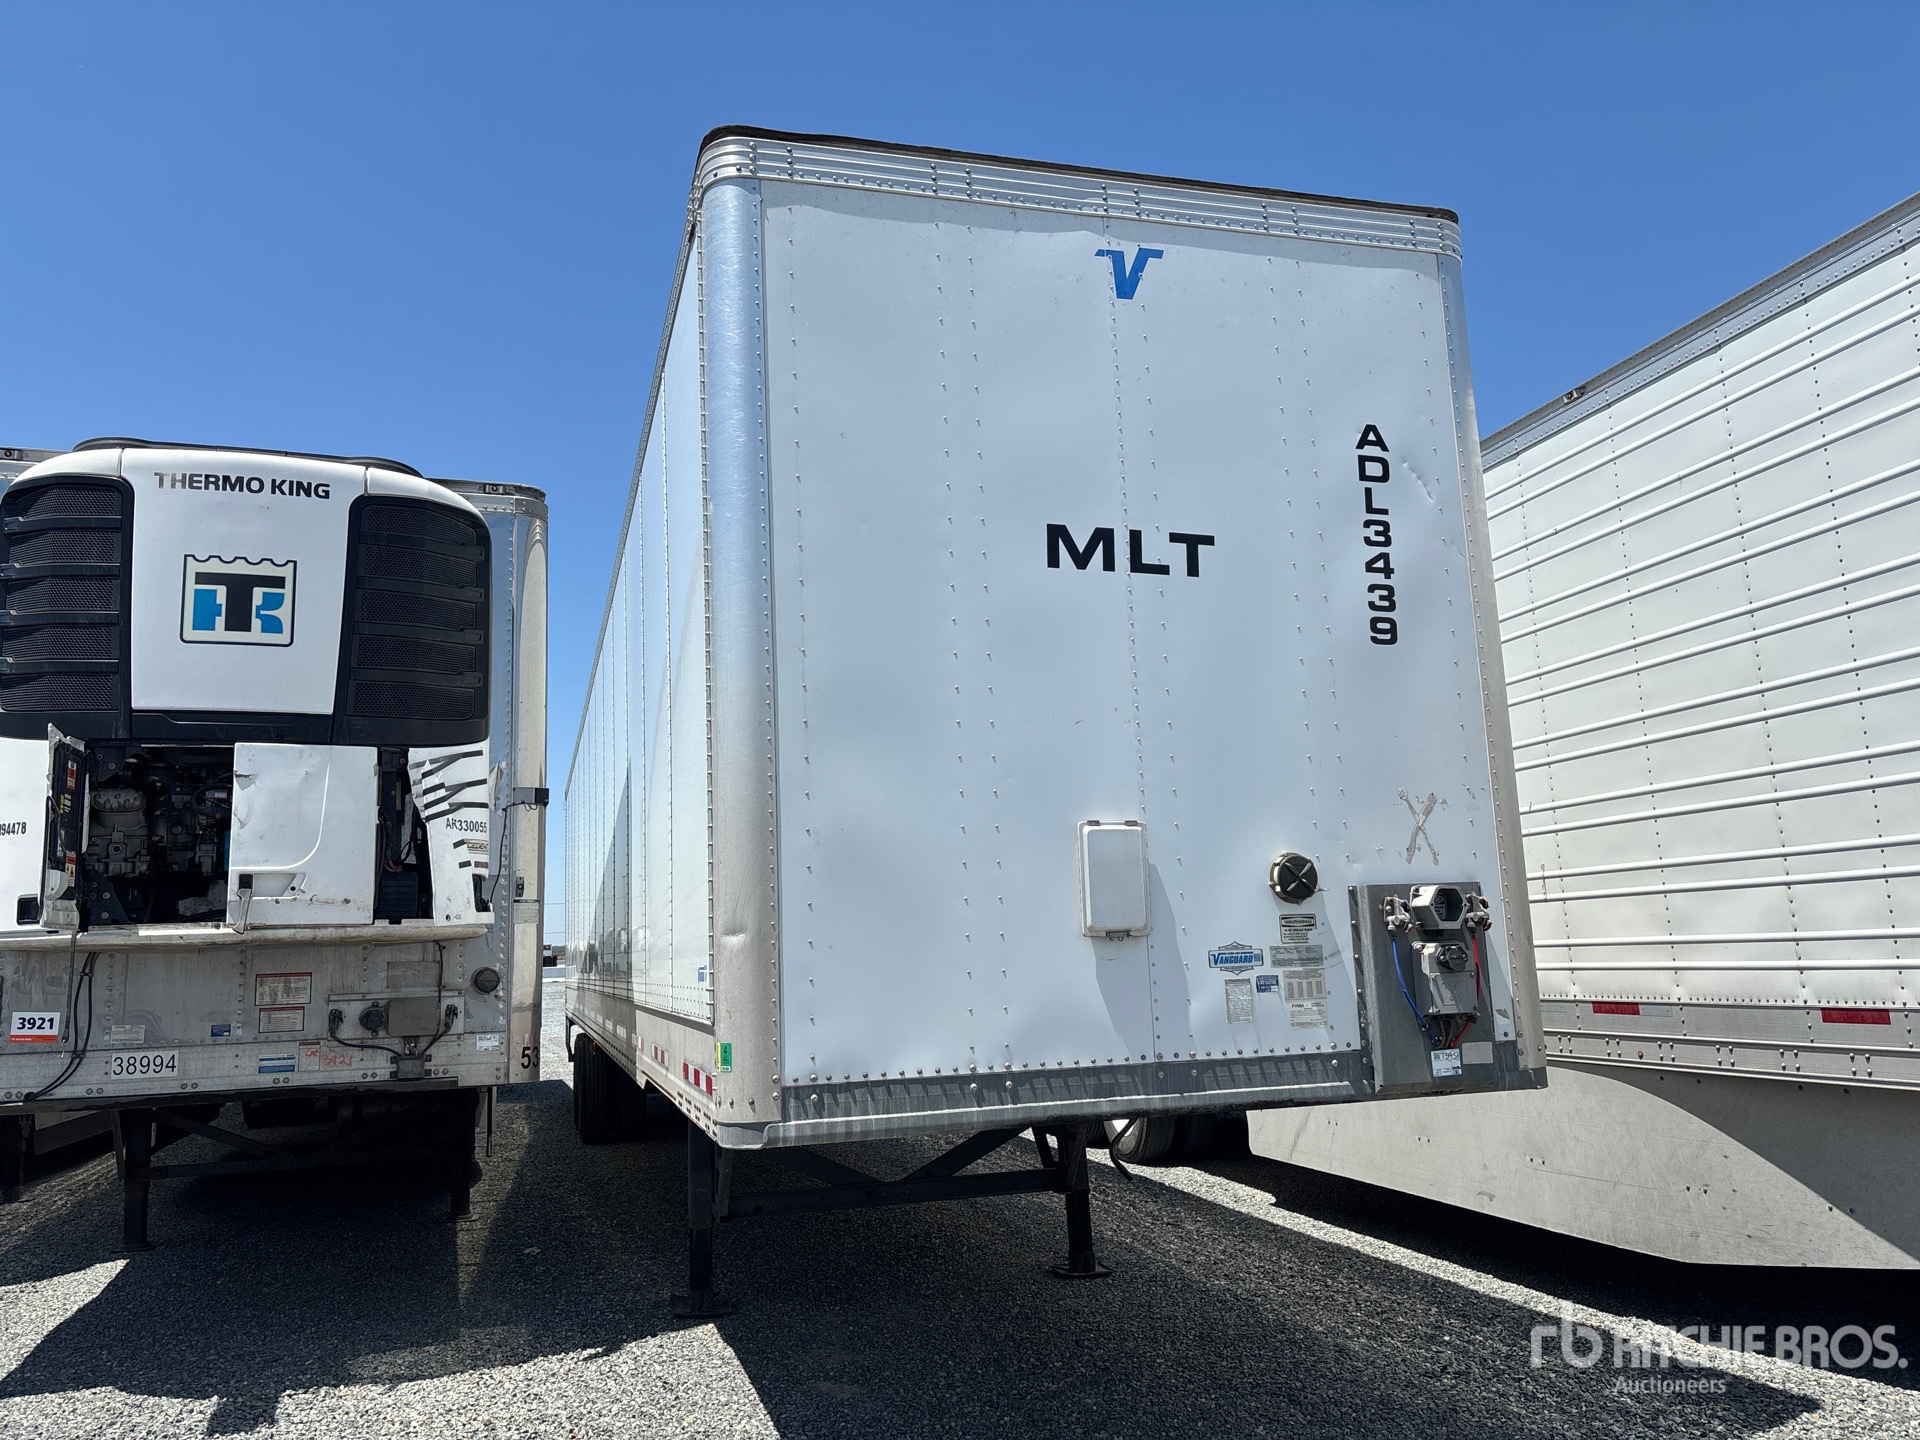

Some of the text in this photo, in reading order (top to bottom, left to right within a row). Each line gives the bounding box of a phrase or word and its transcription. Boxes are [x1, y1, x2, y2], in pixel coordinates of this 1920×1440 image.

[154, 472, 330, 500] THERMO KING
[1355, 424, 1398, 646] ADL3439
[1046, 523, 1216, 578] MLT
[0, 821, 27, 837] 94478
[446, 817, 488, 834] AR330055
[1210, 951, 1254, 966] VANGUARD
[17, 1017, 54, 1030] 3921
[112, 1053, 177, 1076] 38994
[322, 1053, 353, 1067] 3921
[520, 1045, 539, 1070] 53
